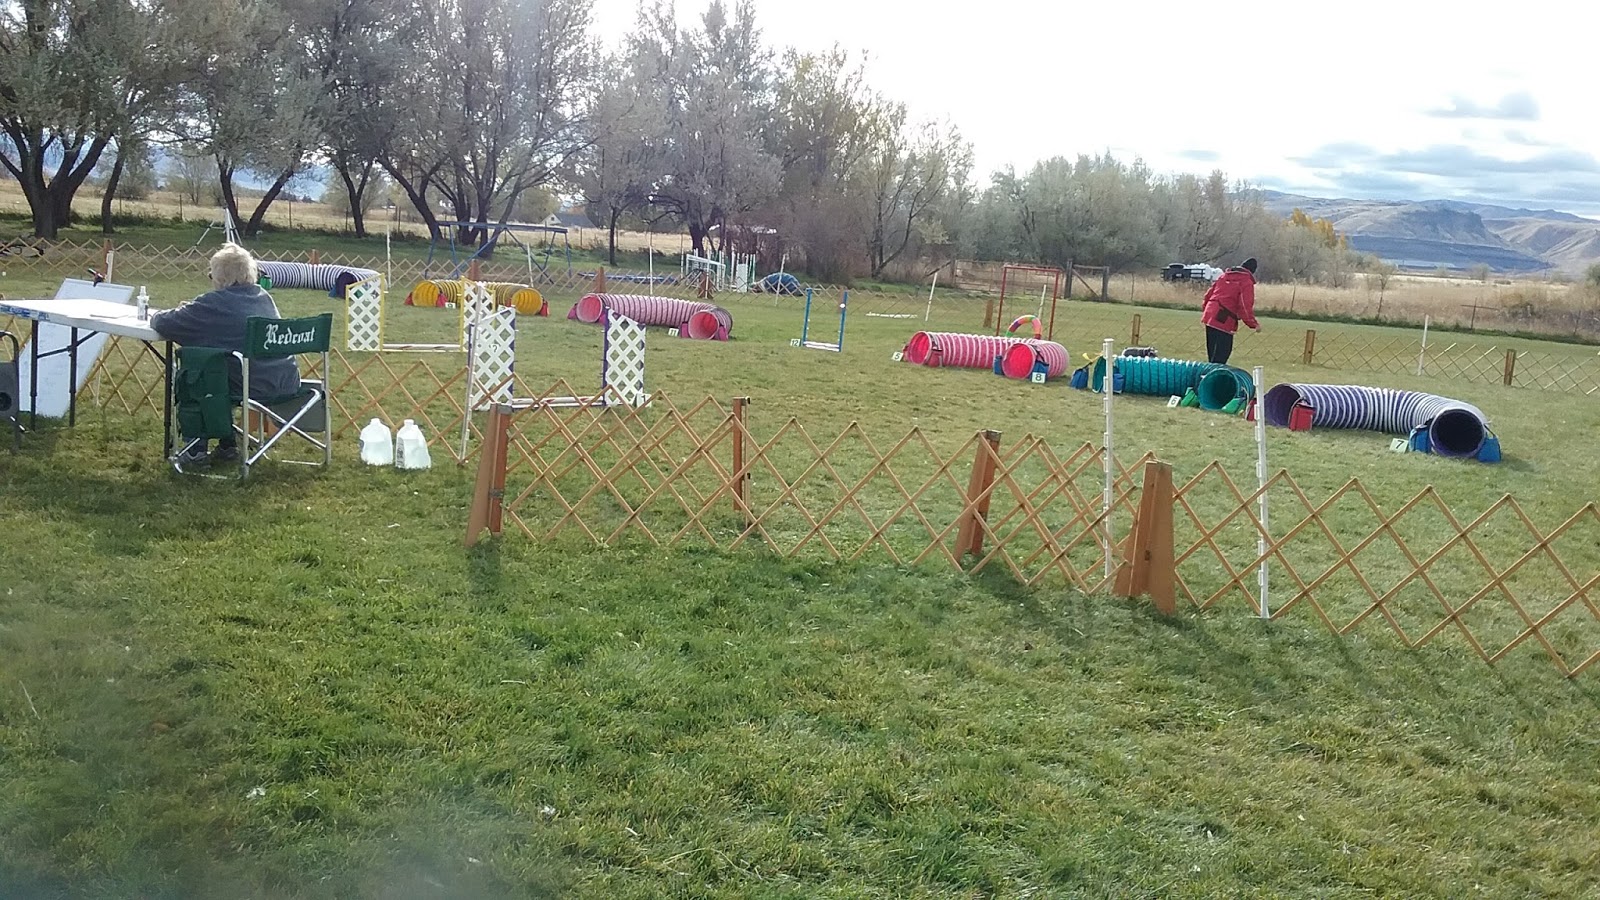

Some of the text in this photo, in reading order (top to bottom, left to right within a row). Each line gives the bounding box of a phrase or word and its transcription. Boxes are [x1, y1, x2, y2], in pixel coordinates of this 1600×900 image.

[263, 323, 316, 350] Redcoat
[894, 352, 901, 360] 5
[1035, 373, 1042, 381] 8
[1171, 396, 1178, 405] 6
[1396, 439, 1404, 449] 7
